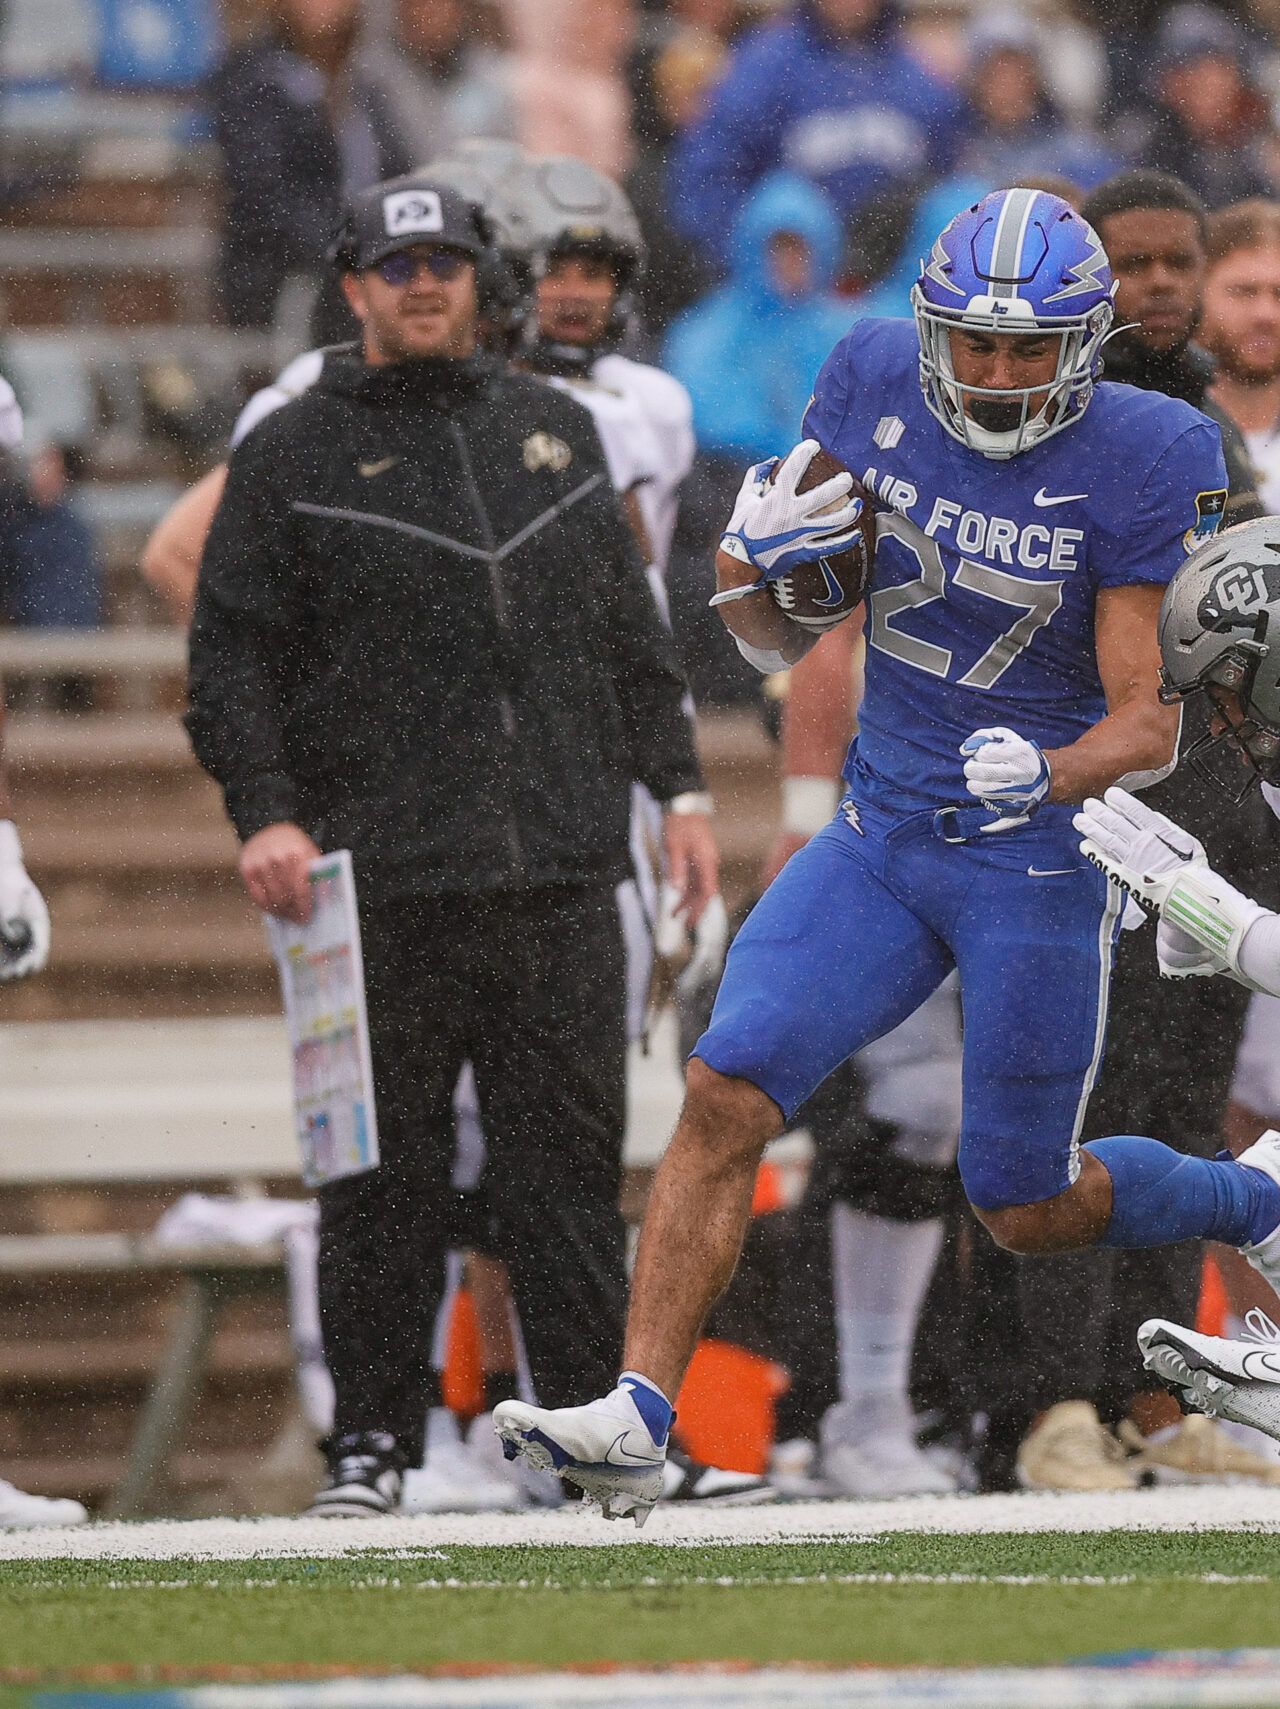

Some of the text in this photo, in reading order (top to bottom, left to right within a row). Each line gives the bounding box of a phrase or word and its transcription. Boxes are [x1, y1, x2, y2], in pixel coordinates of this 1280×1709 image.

[924, 497, 1084, 571] FORCE
[870, 509, 1066, 690] 27
[1215, 565, 1270, 615] CU
